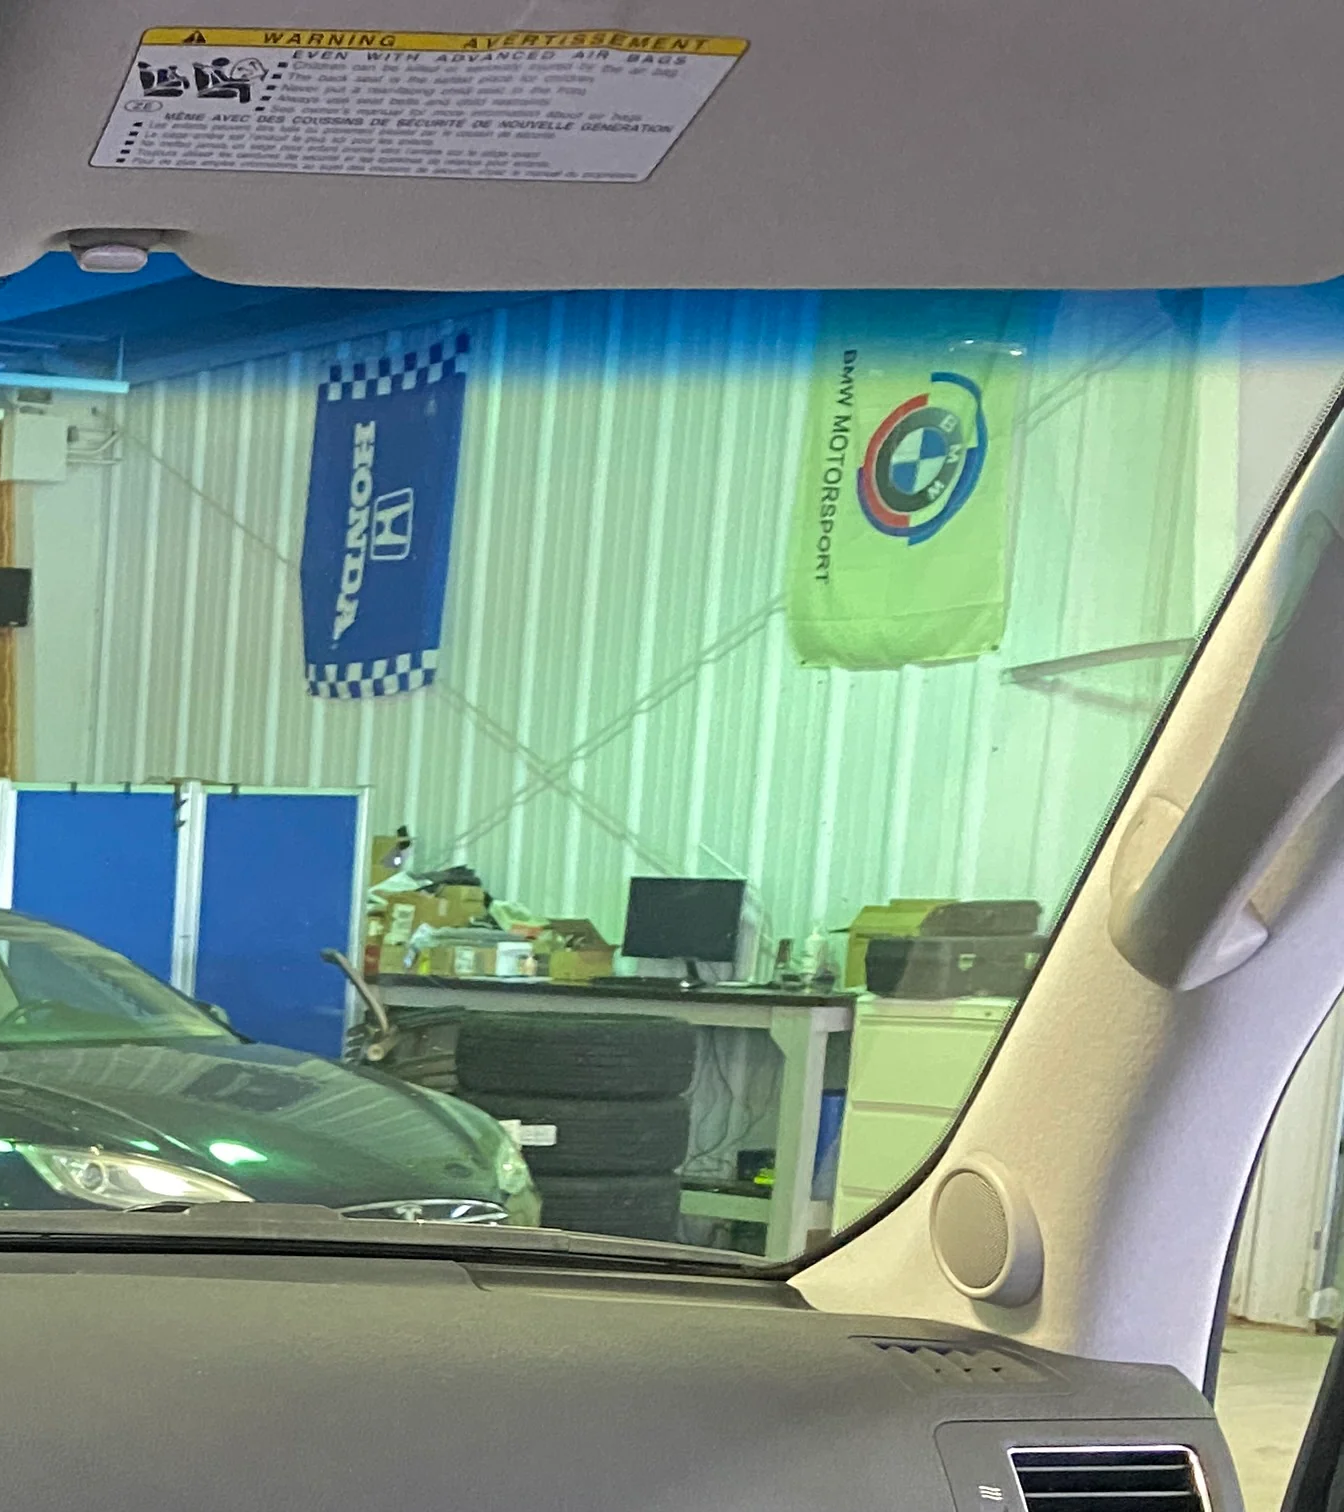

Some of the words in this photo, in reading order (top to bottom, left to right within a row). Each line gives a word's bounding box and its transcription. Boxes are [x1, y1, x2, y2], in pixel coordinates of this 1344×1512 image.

[264, 32, 397, 47] WARNING
[463, 31, 710, 50] AVERTISSEMENT
[293, 50, 349, 61] EVEN
[367, 51, 418, 61] WITH
[435, 50, 557, 63] ADVANCED
[572, 50, 610, 60] AIR
[626, 54, 687, 65] BAGS
[836, 348, 858, 407] BMW
[925, 413, 963, 502] BMW
[330, 420, 376, 643] HONDA
[814, 414, 853, 586] MOTORSPORT
